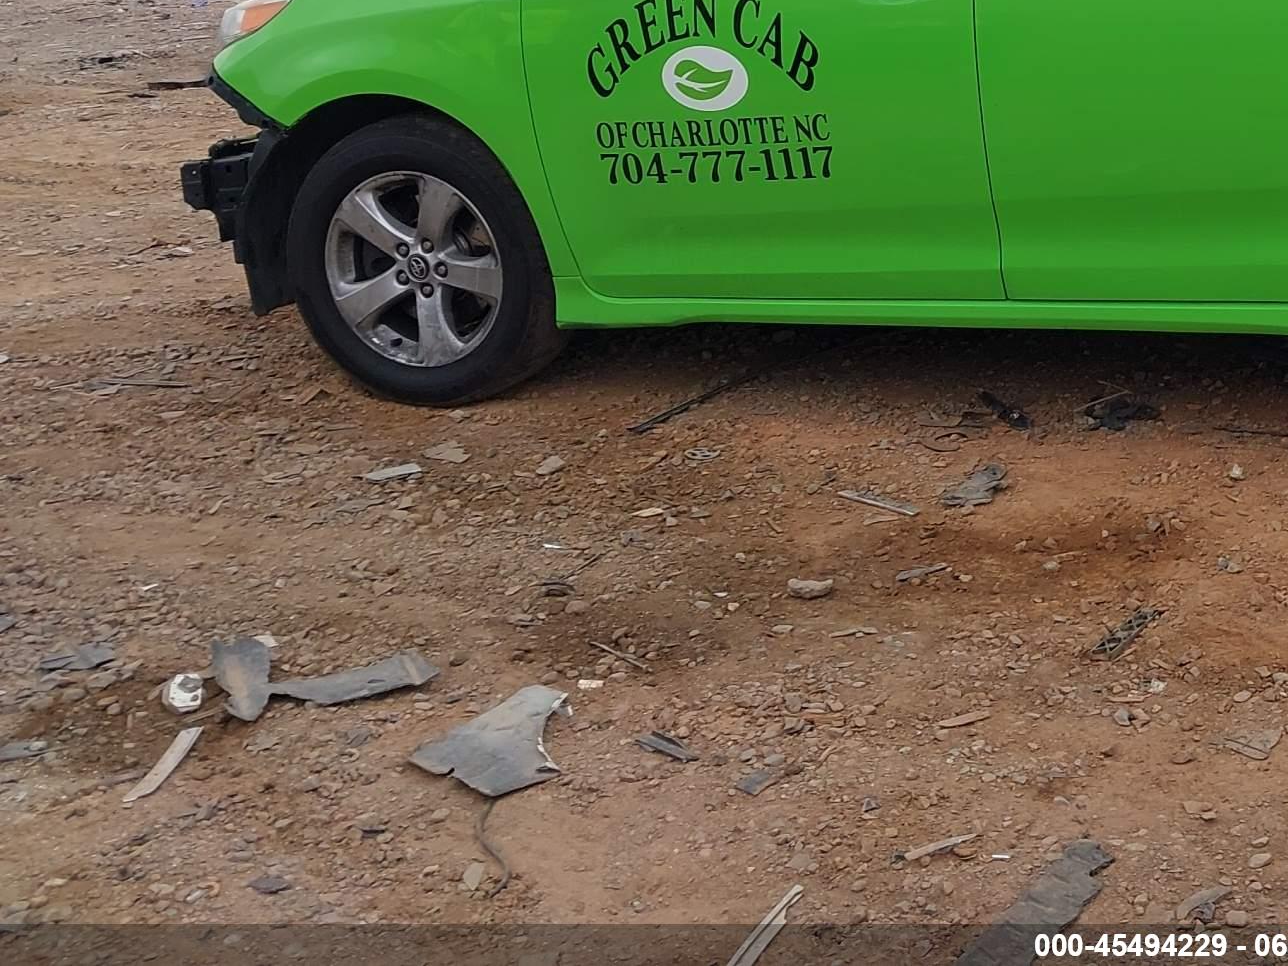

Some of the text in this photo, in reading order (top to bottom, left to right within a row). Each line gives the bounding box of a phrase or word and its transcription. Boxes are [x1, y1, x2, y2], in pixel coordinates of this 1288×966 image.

[596, 113, 832, 149] OF CHARLOTTE NC
[599, 145, 834, 185] 704-777-1117
